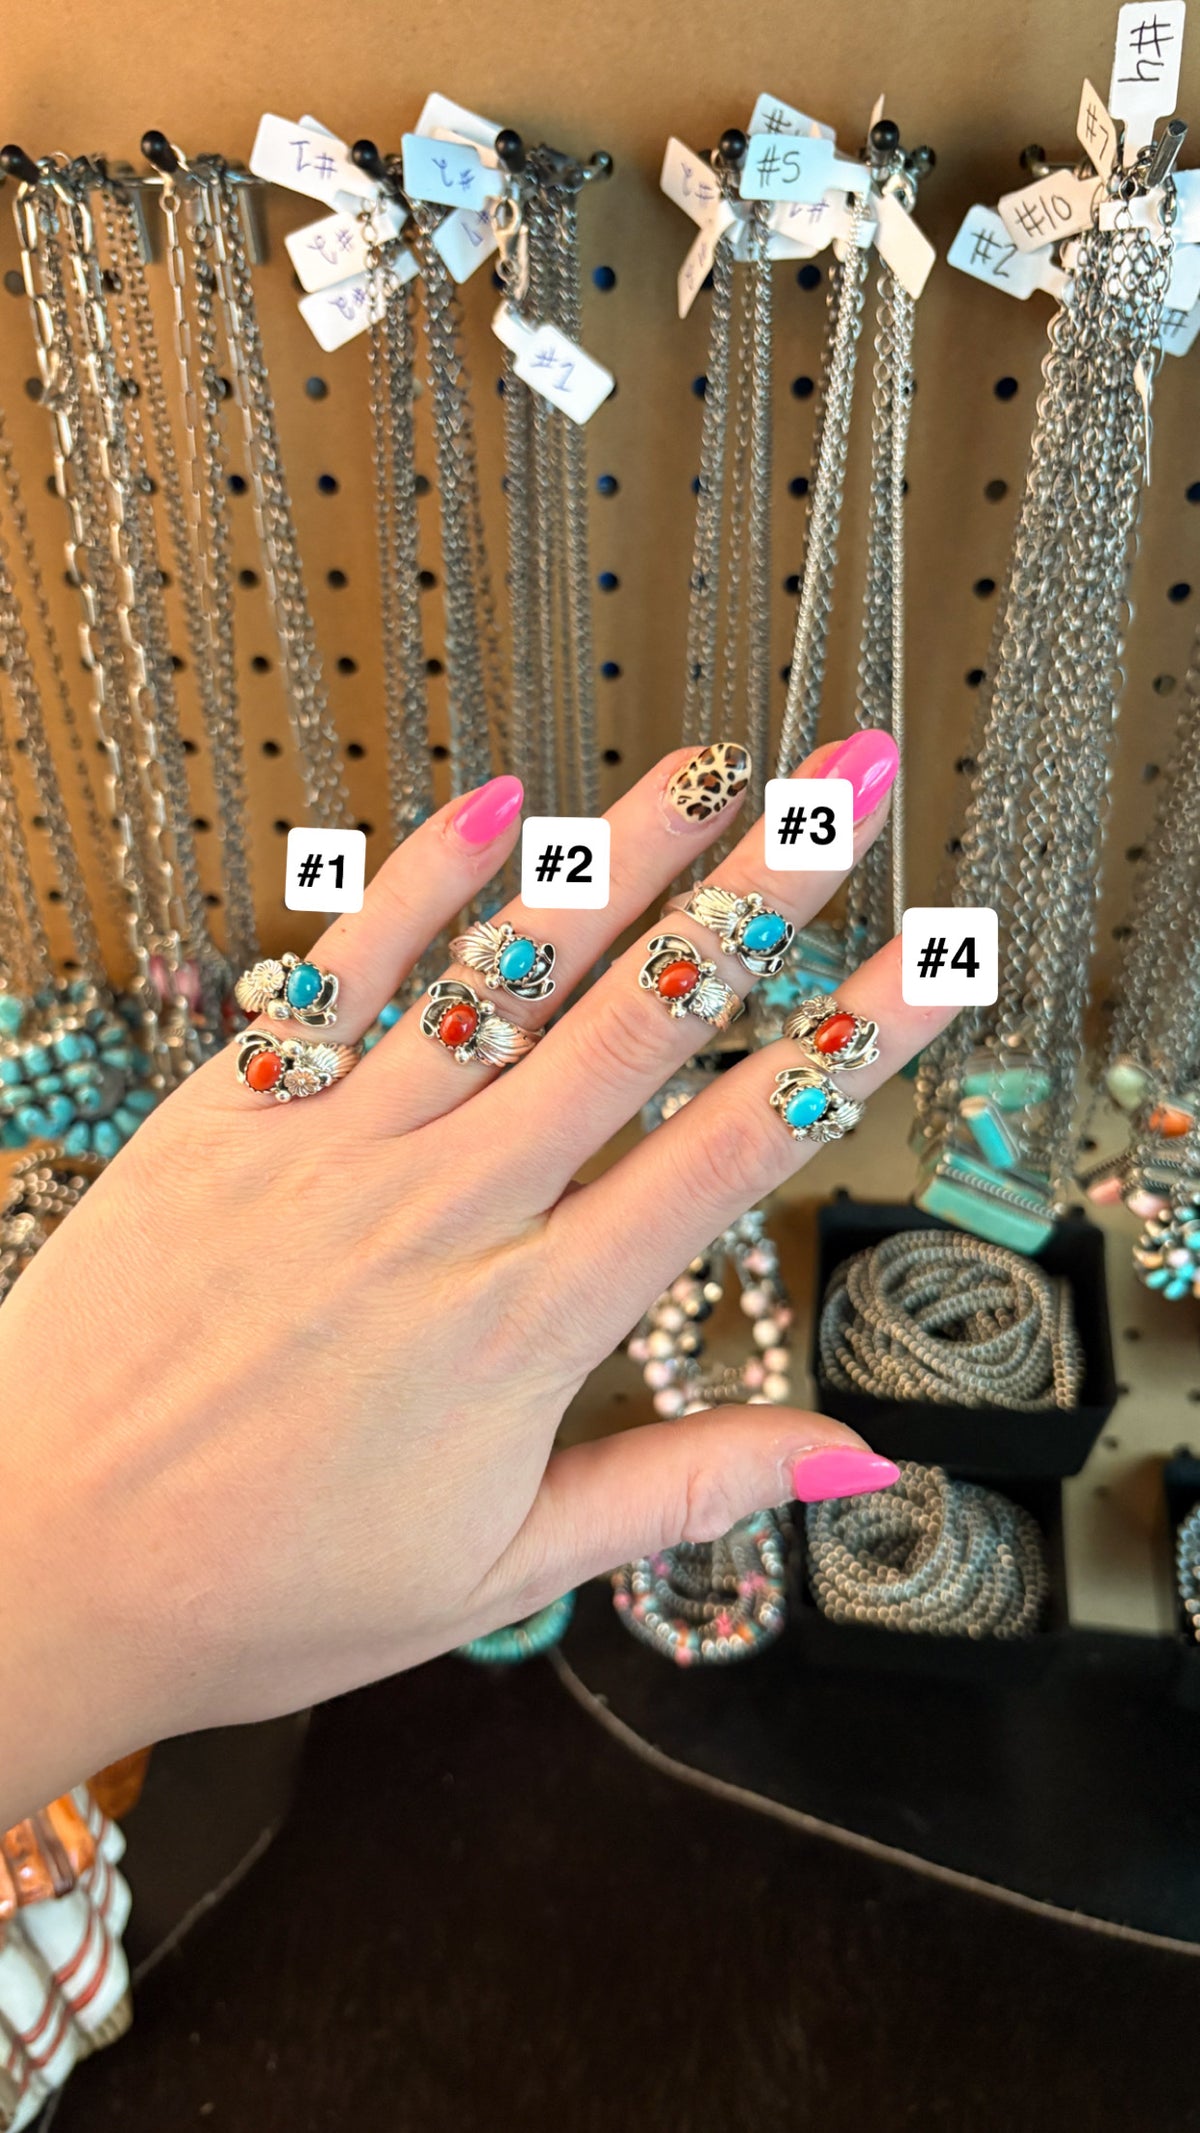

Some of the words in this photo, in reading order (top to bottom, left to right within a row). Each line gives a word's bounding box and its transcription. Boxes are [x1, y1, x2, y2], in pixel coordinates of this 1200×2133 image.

[757, 145, 800, 188] #5
[1015, 195, 1072, 237] #10
[529, 346, 573, 392] #1
